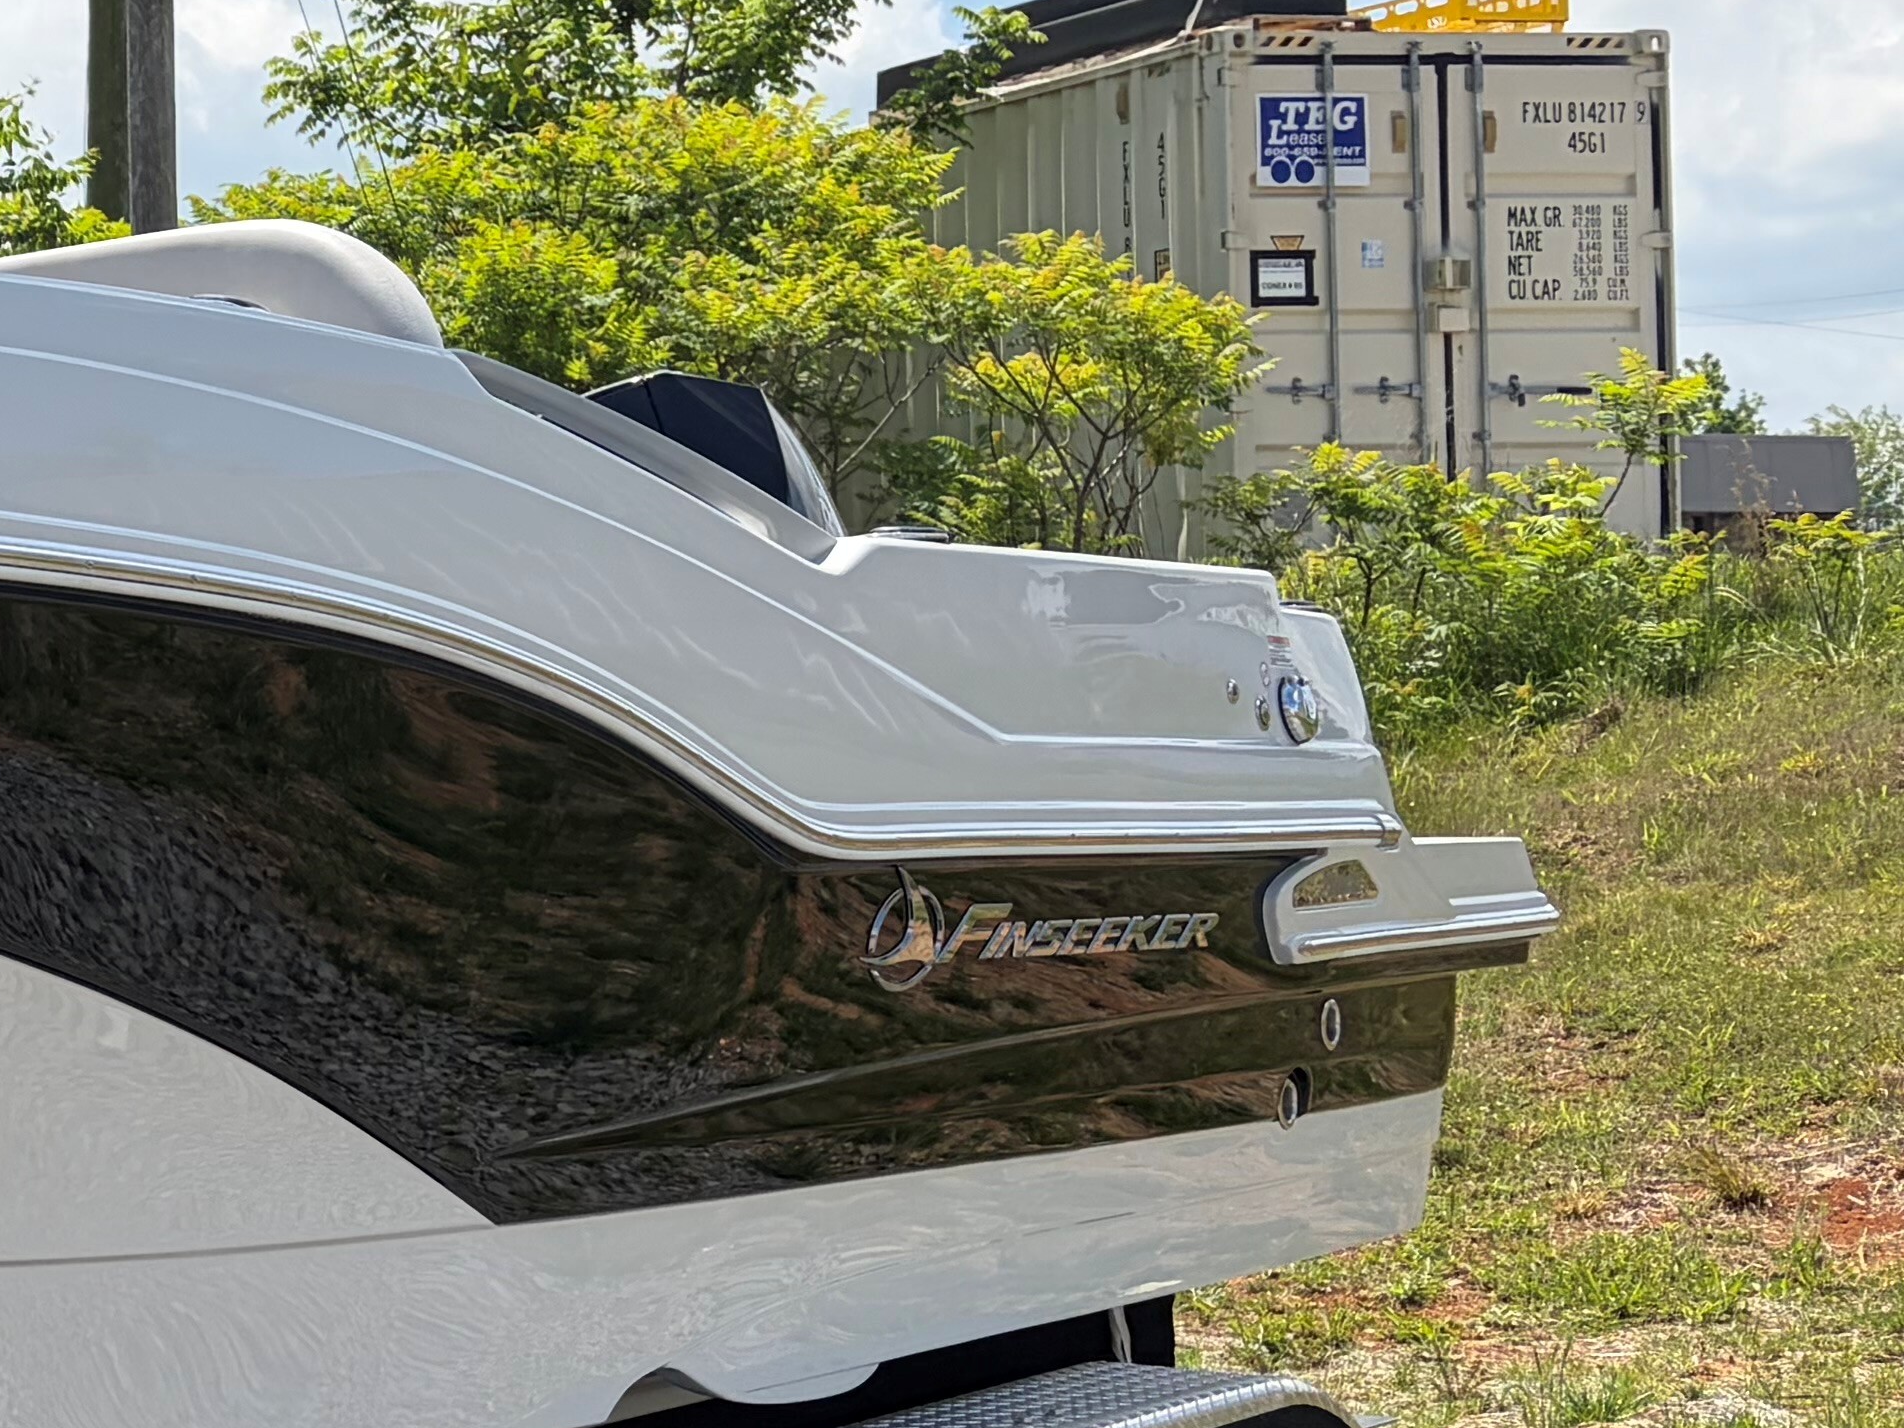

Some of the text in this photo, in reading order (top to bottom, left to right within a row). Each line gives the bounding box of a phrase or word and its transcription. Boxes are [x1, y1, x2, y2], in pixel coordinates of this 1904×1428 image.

[1279, 101, 1358, 131] TEG
[1522, 101, 1646, 123] FXLU 814217 9
[1568, 131, 1605, 153] 45G1
[1157, 132, 1166, 220] 45G1
[1613, 217, 1628, 228] LBS
[1508, 230, 1543, 252] TARE
[1508, 254, 1533, 276] NET
[935, 902, 1220, 964] FINSEEKER
